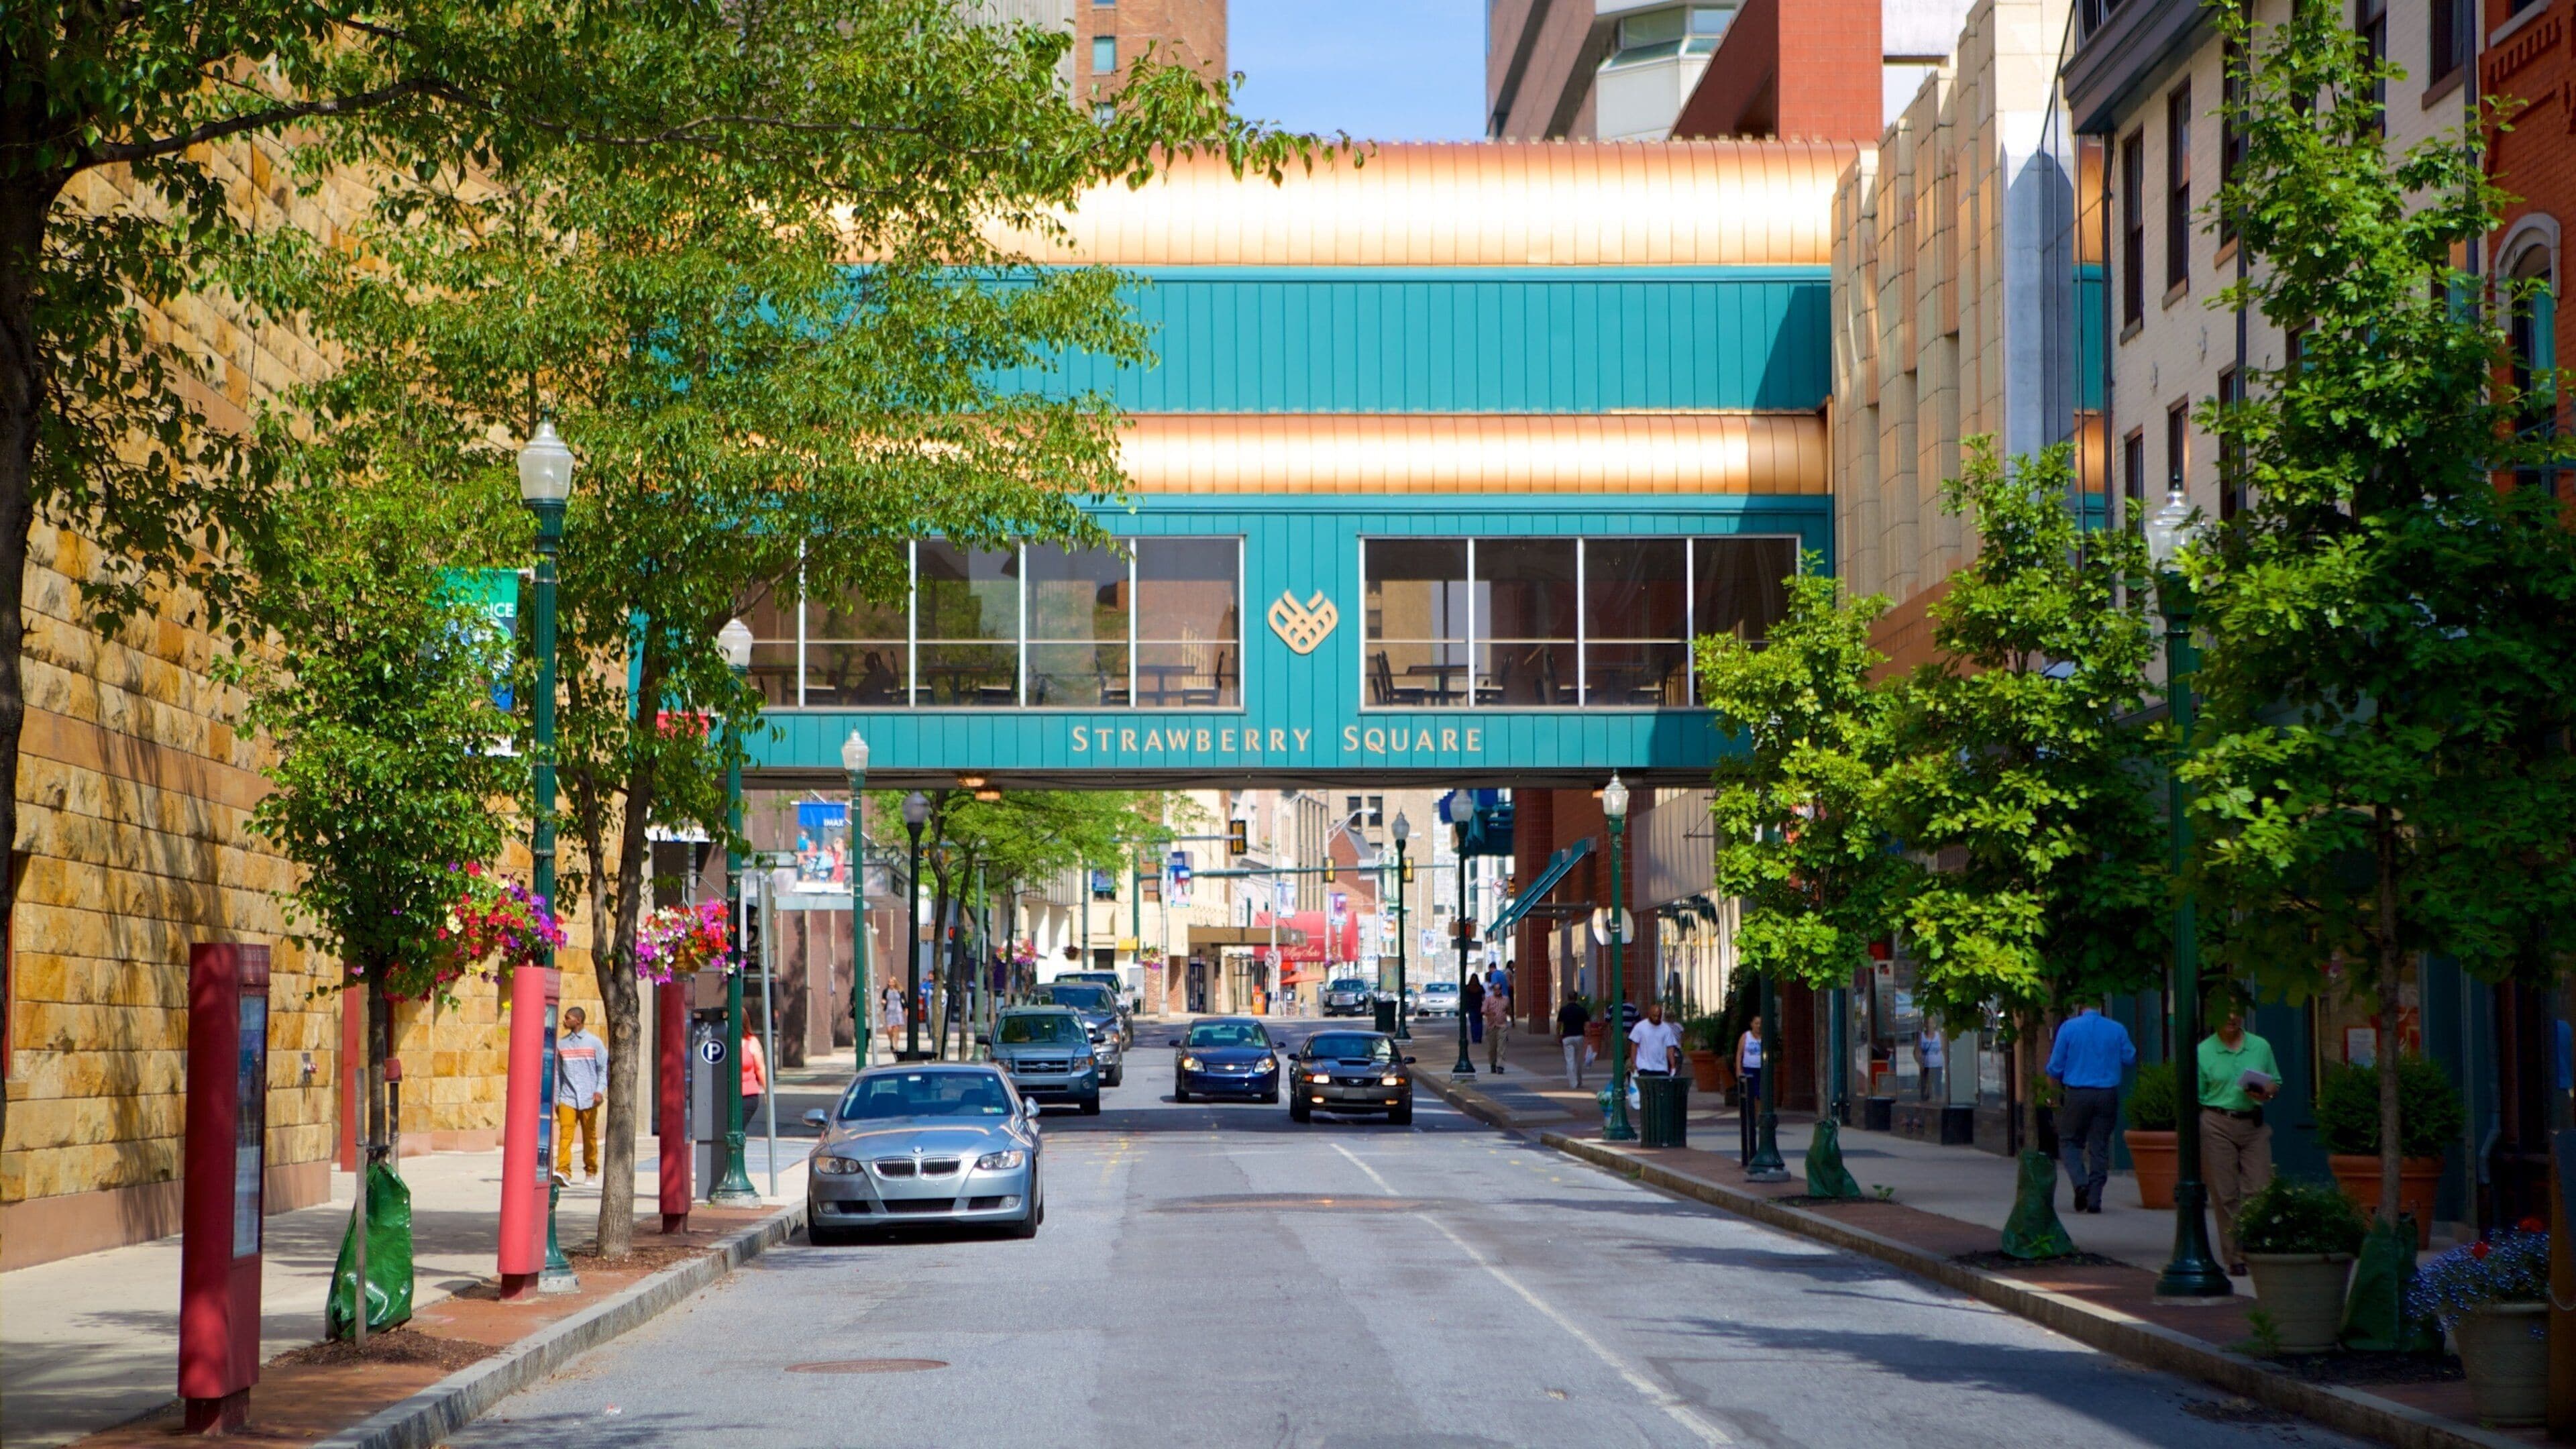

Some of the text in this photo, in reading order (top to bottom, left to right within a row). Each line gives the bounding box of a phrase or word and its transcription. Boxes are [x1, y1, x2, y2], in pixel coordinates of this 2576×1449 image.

[1072, 725, 1482, 754] STRAWBERRY SQUARE
[823, 818, 844, 827] IMAX
[708, 1043, 721, 1060] P
